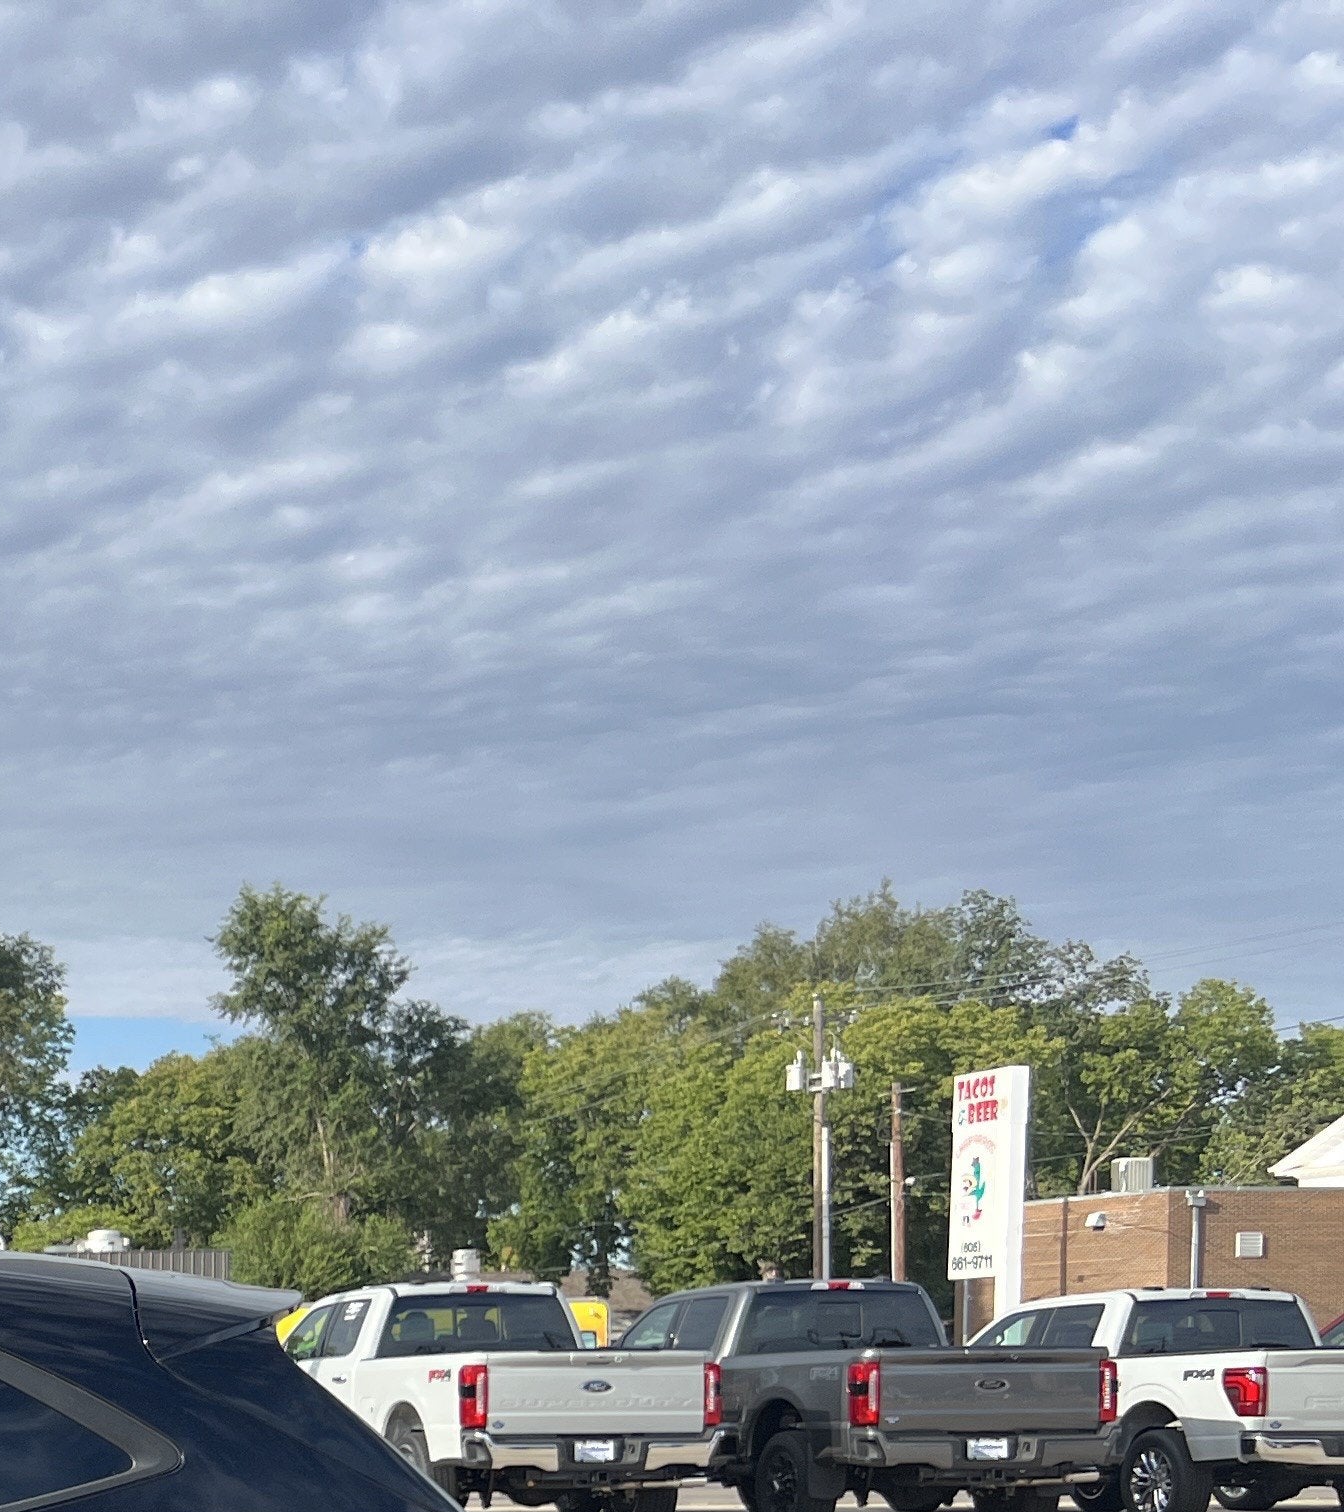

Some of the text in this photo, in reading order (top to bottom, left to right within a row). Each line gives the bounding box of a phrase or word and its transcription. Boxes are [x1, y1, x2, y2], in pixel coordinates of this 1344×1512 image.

[958, 1075, 995, 1101] TACOS
[968, 1100, 998, 1124] BEER
[951, 1255, 993, 1271] 661-9711
[1183, 1369, 1215, 1381] FX4
